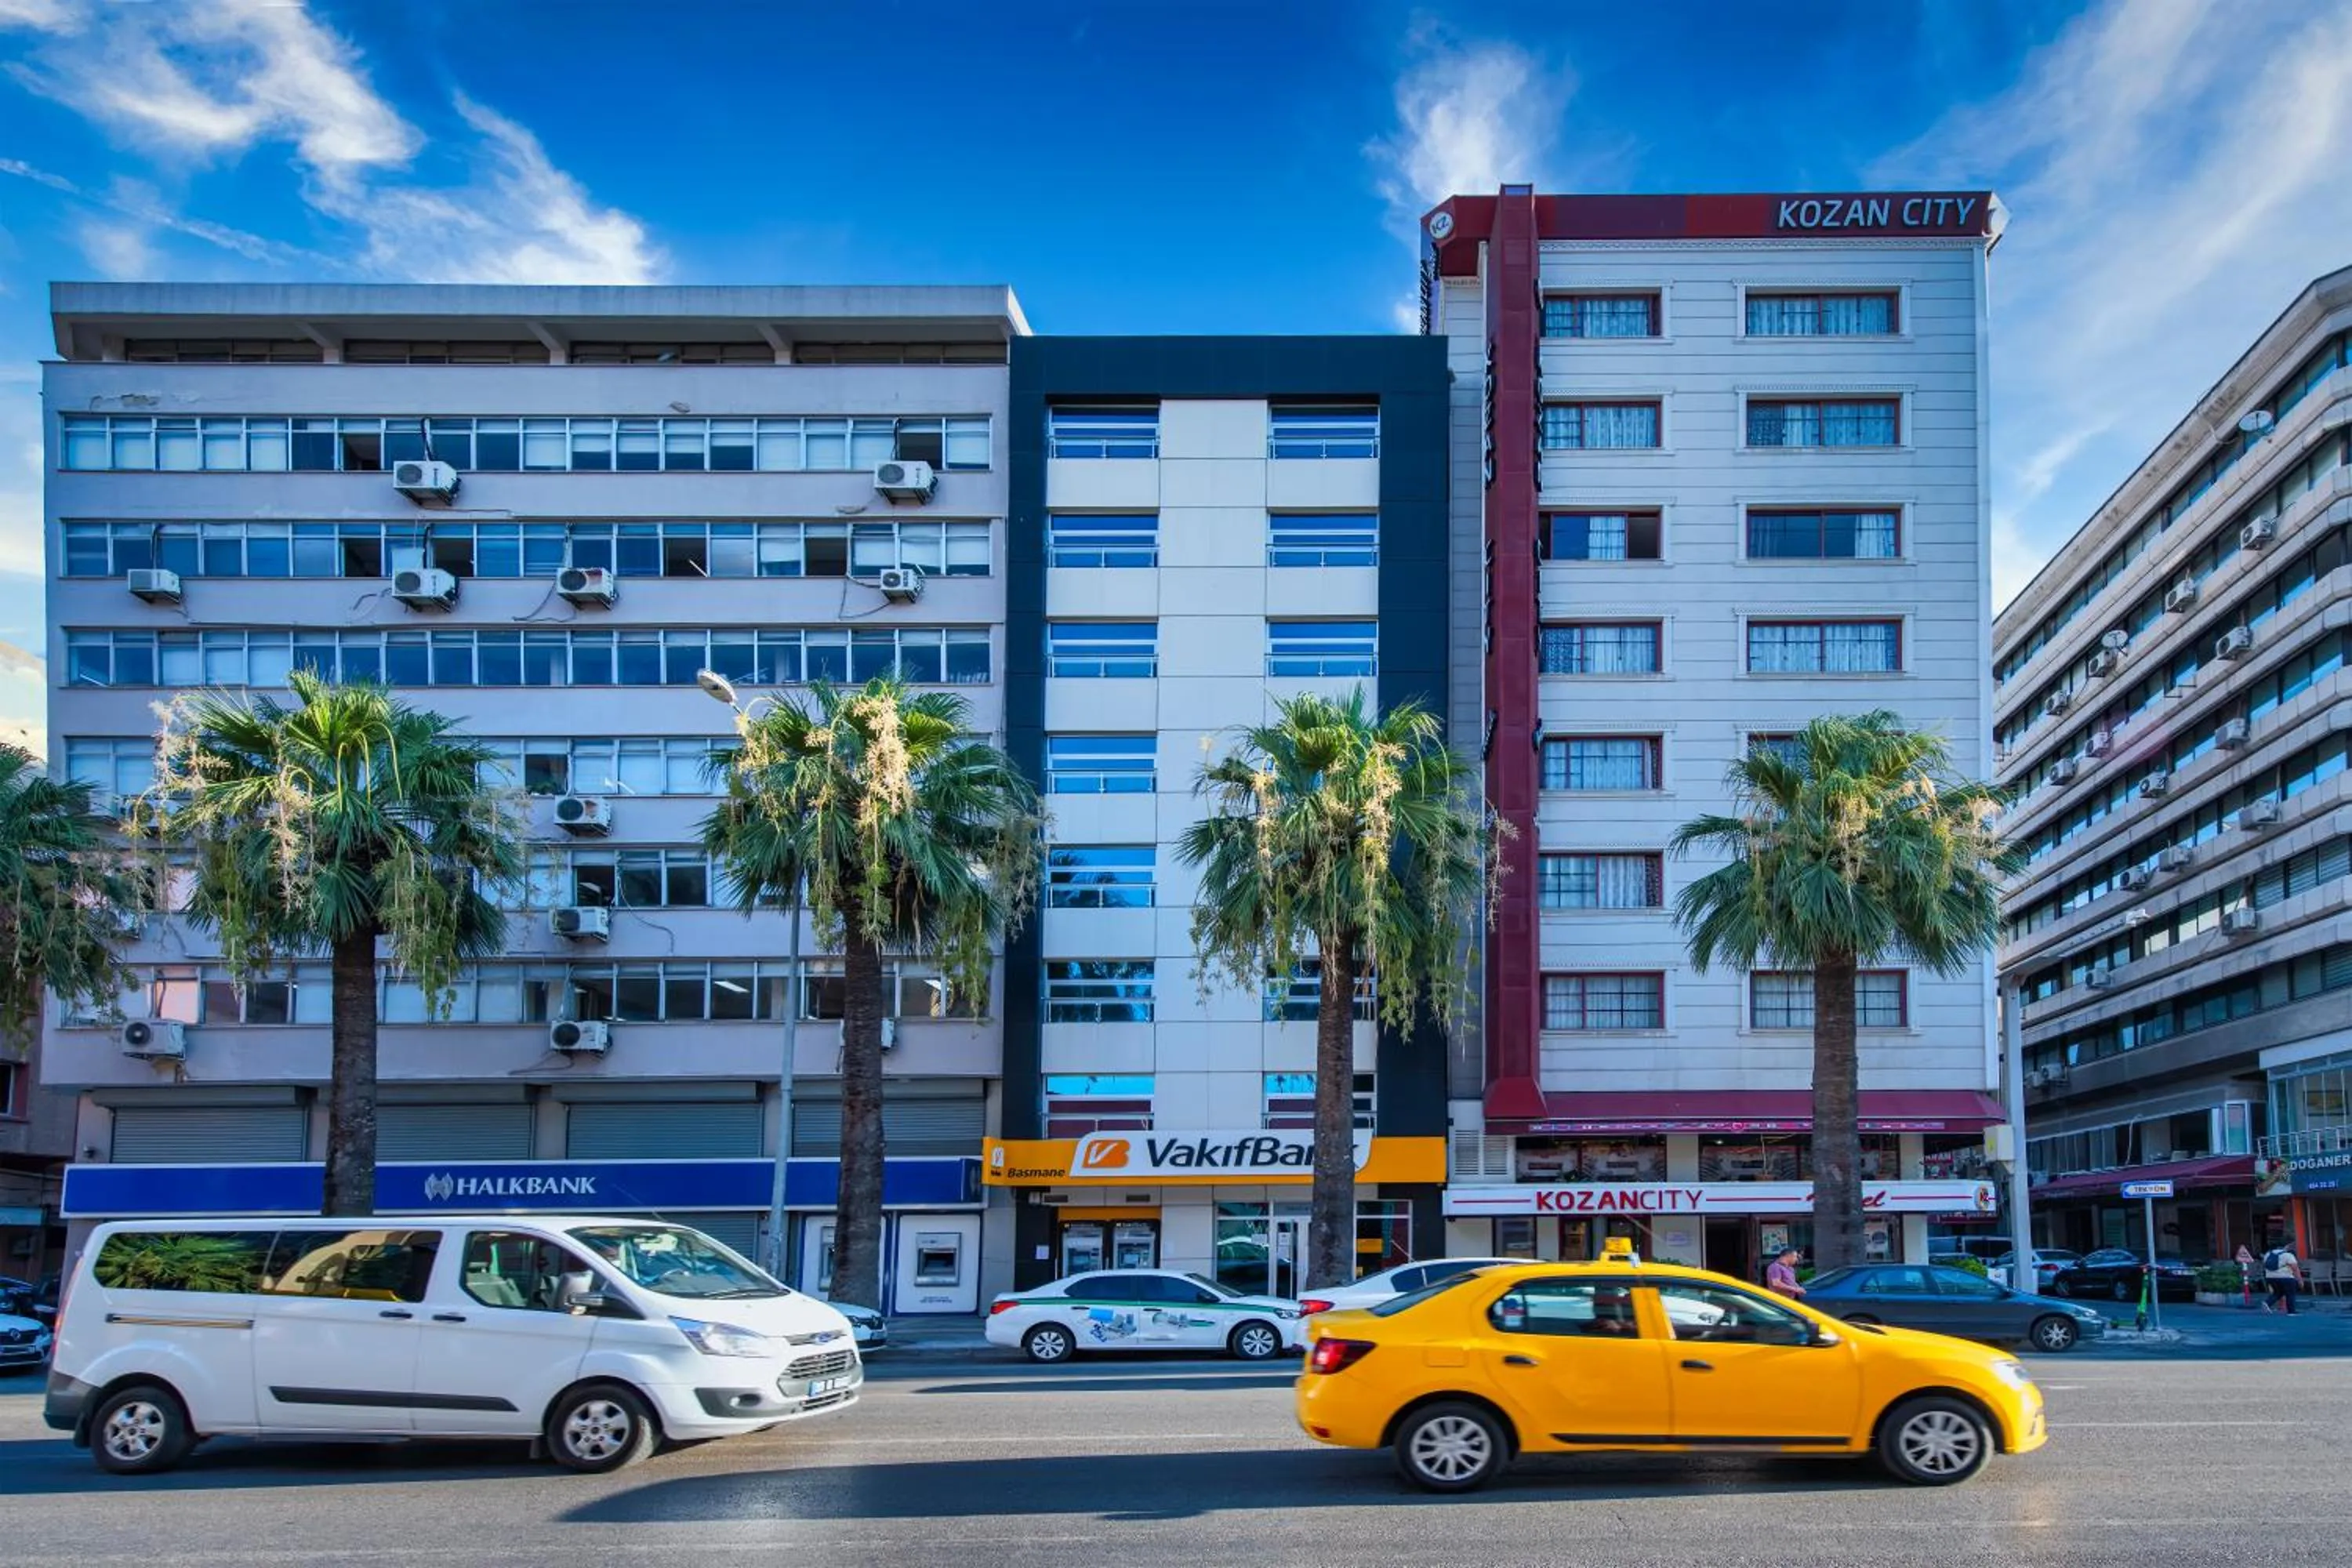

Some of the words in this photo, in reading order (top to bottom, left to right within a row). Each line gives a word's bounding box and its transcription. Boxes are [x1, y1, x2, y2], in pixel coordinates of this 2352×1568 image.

[1777, 198, 1891, 228] KOZAN
[1902, 198, 1976, 226] CITY
[1146, 1136, 1359, 1169] VakıfBa
[1007, 1167, 1065, 1178] Basmane
[456, 1176, 597, 1196] HALKBANK
